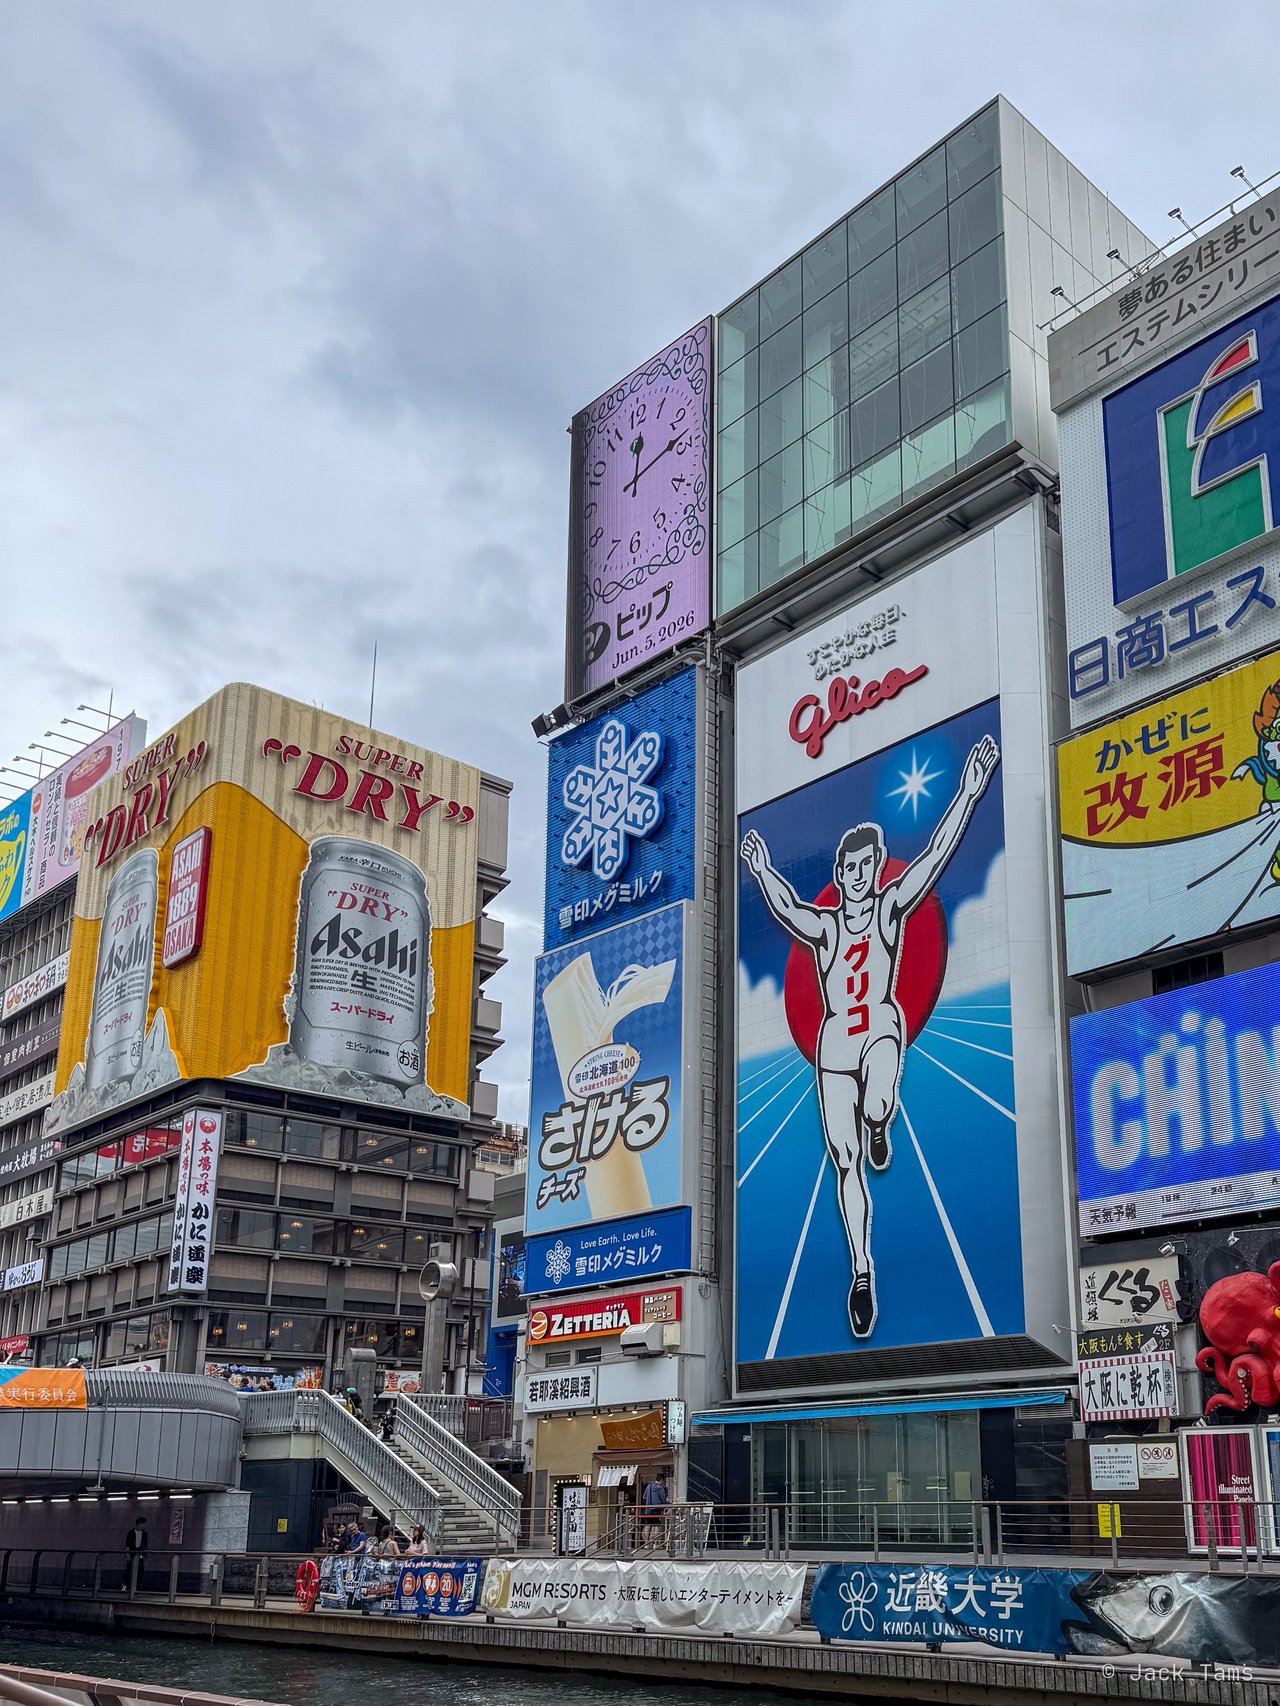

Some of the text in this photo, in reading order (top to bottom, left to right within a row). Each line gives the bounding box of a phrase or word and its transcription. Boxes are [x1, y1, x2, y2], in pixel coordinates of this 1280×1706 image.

[1118, 208, 1276, 322] 夢ある住まい
[1097, 250, 1280, 371] エステムシリー
[628, 404, 646, 430] 12
[656, 397, 666, 419] 1
[670, 408, 686, 431] 2
[607, 428, 624, 452] 11
[676, 435, 693, 455] 3
[589, 460, 606, 488] 10
[671, 472, 686, 492] 4
[653, 506, 666, 529] 5
[589, 527, 603, 548] 8
[606, 539, 621, 560] 7
[629, 531, 641, 553] 6
[616, 581, 673, 641] ピップ
[612, 610, 694, 668] Jun. 5, 2026
[1069, 566, 1280, 700] 日商エス
[789, 664, 929, 758] Glico
[1095, 707, 1211, 774] かぜに
[123, 732, 176, 790] SUPER
[333, 735, 426, 782] SUPER
[1083, 733, 1228, 837] 改源
[171, 837, 204, 883] ASAHI
[168, 881, 199, 925] 1889
[350, 882, 390, 900] SUPER
[558, 870, 662, 930] 雪印メグミルク
[163, 917, 194, 960] OSAKA
[310, 912, 418, 979] Asahi
[99, 923, 150, 991] Asahi
[351, 970, 377, 993] 生
[843, 934, 871, 1036] グリコ
[330, 1001, 395, 1024] スーパードライ
[399, 1049, 420, 1071] お酒
[540, 1077, 669, 1170] さける
[195, 1138, 214, 1197] 本場の味
[537, 1167, 586, 1209] チーズ
[15, 1194, 44, 1221] 白木屋
[1089, 1201, 1137, 1225] 天気予報
[185, 1201, 209, 1285] かに道楽
[581, 1227, 657, 1249] Love Earth. Love Life.
[575, 1243, 662, 1276] 雪印メグミルク
[1085, 1272, 1098, 1321] 道頓堀
[1098, 1268, 1160, 1315] くくる
[551, 1309, 631, 1336] ZETTERIA
[1153, 1325, 1170, 1338] くくる
[1079, 1332, 1144, 1355] 大阪もんを食す
[1159, 1339, 1170, 1350] 2F
[1085, 1365, 1162, 1410] 大阪に乾杯
[1218, 1484, 1253, 1495] Illuminated
[1231, 1474, 1251, 1486] Street
[510, 1600, 530, 1609] JAPAN
[511, 1582, 541, 1599] MGM
[544, 1583, 606, 1601] RESORTS
[885, 1571, 1024, 1620] 近畿大学
[882, 1621, 1024, 1644] KINDAI UNIVERSITY
